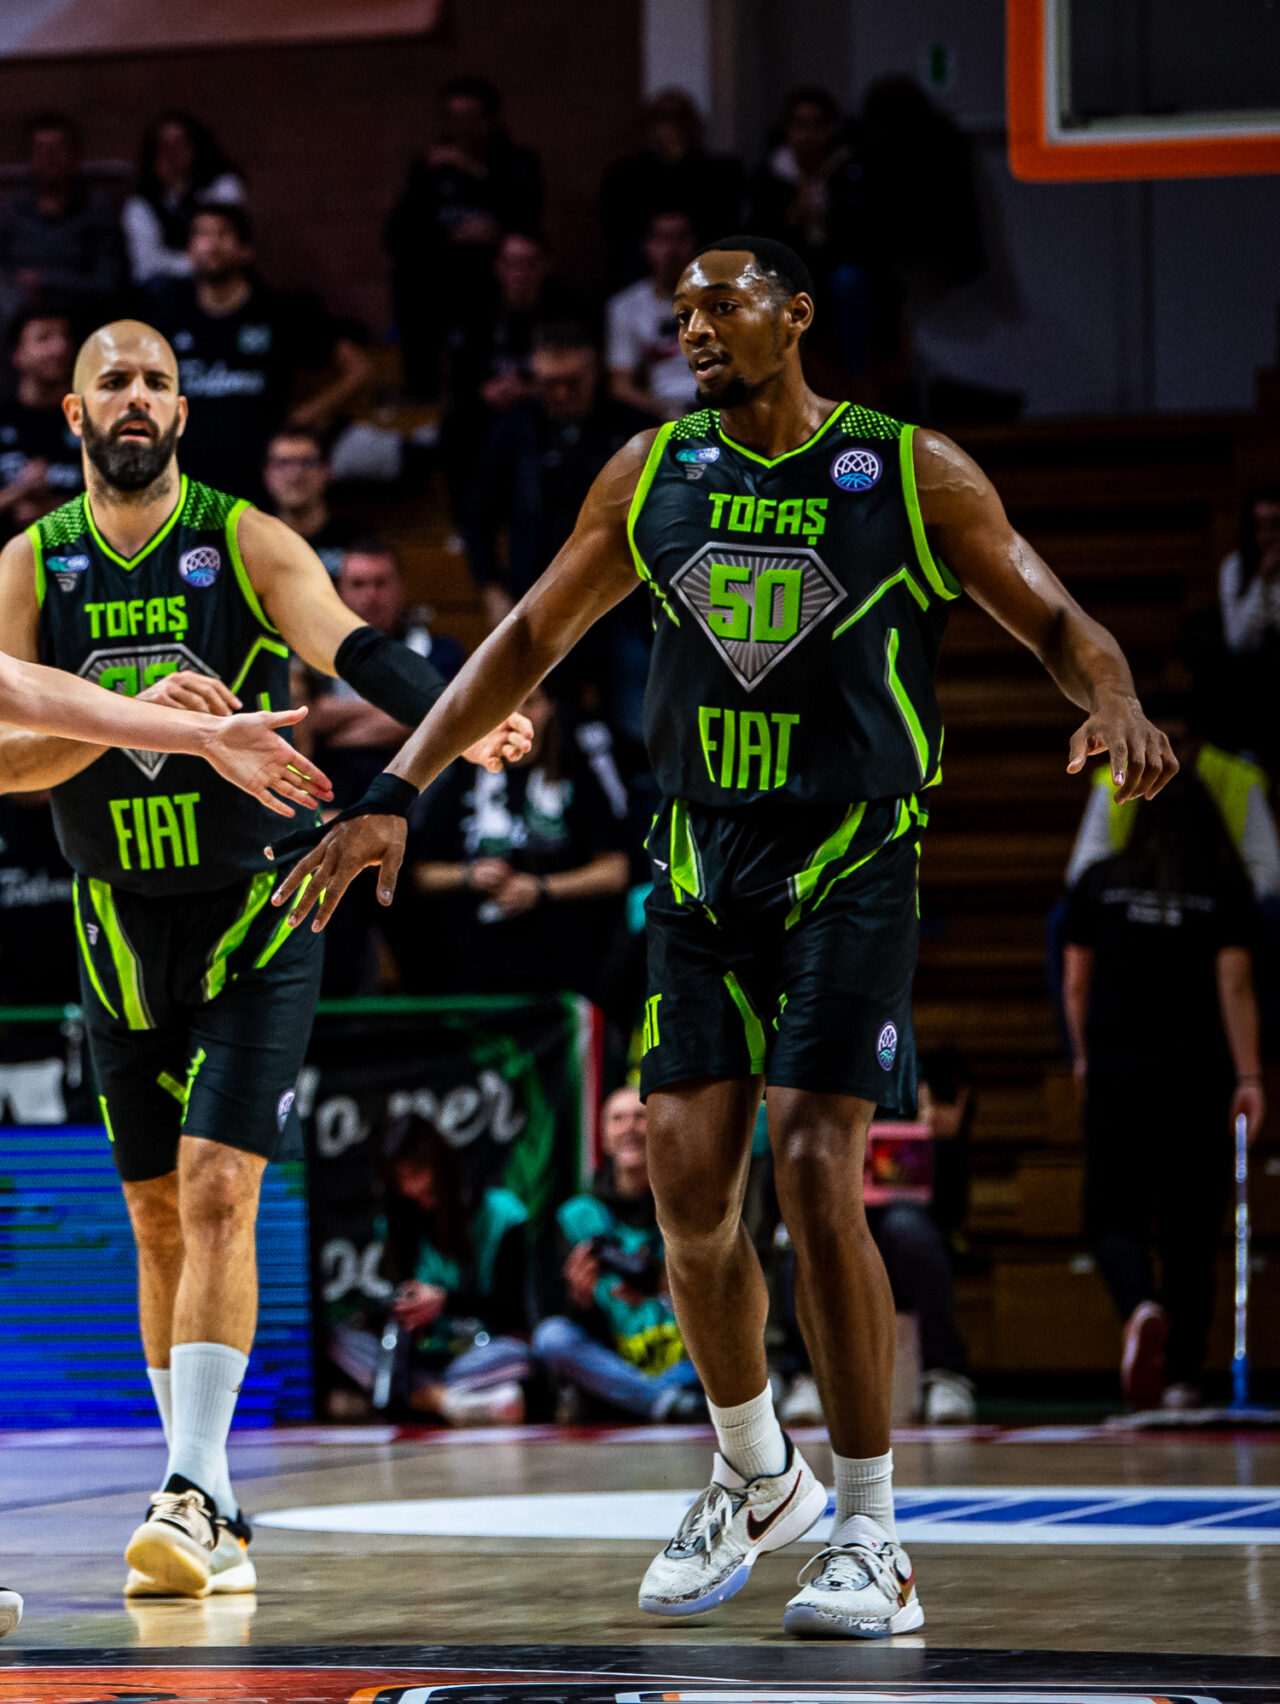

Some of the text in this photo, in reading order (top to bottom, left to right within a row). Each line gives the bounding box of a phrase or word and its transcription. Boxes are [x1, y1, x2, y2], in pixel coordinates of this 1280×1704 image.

[708, 493, 829, 546] TOFAŞ
[84, 595, 189, 641] TOFAŞ
[708, 564, 803, 642] 50
[698, 706, 800, 791] FIAT
[108, 791, 201, 871] FIAT
